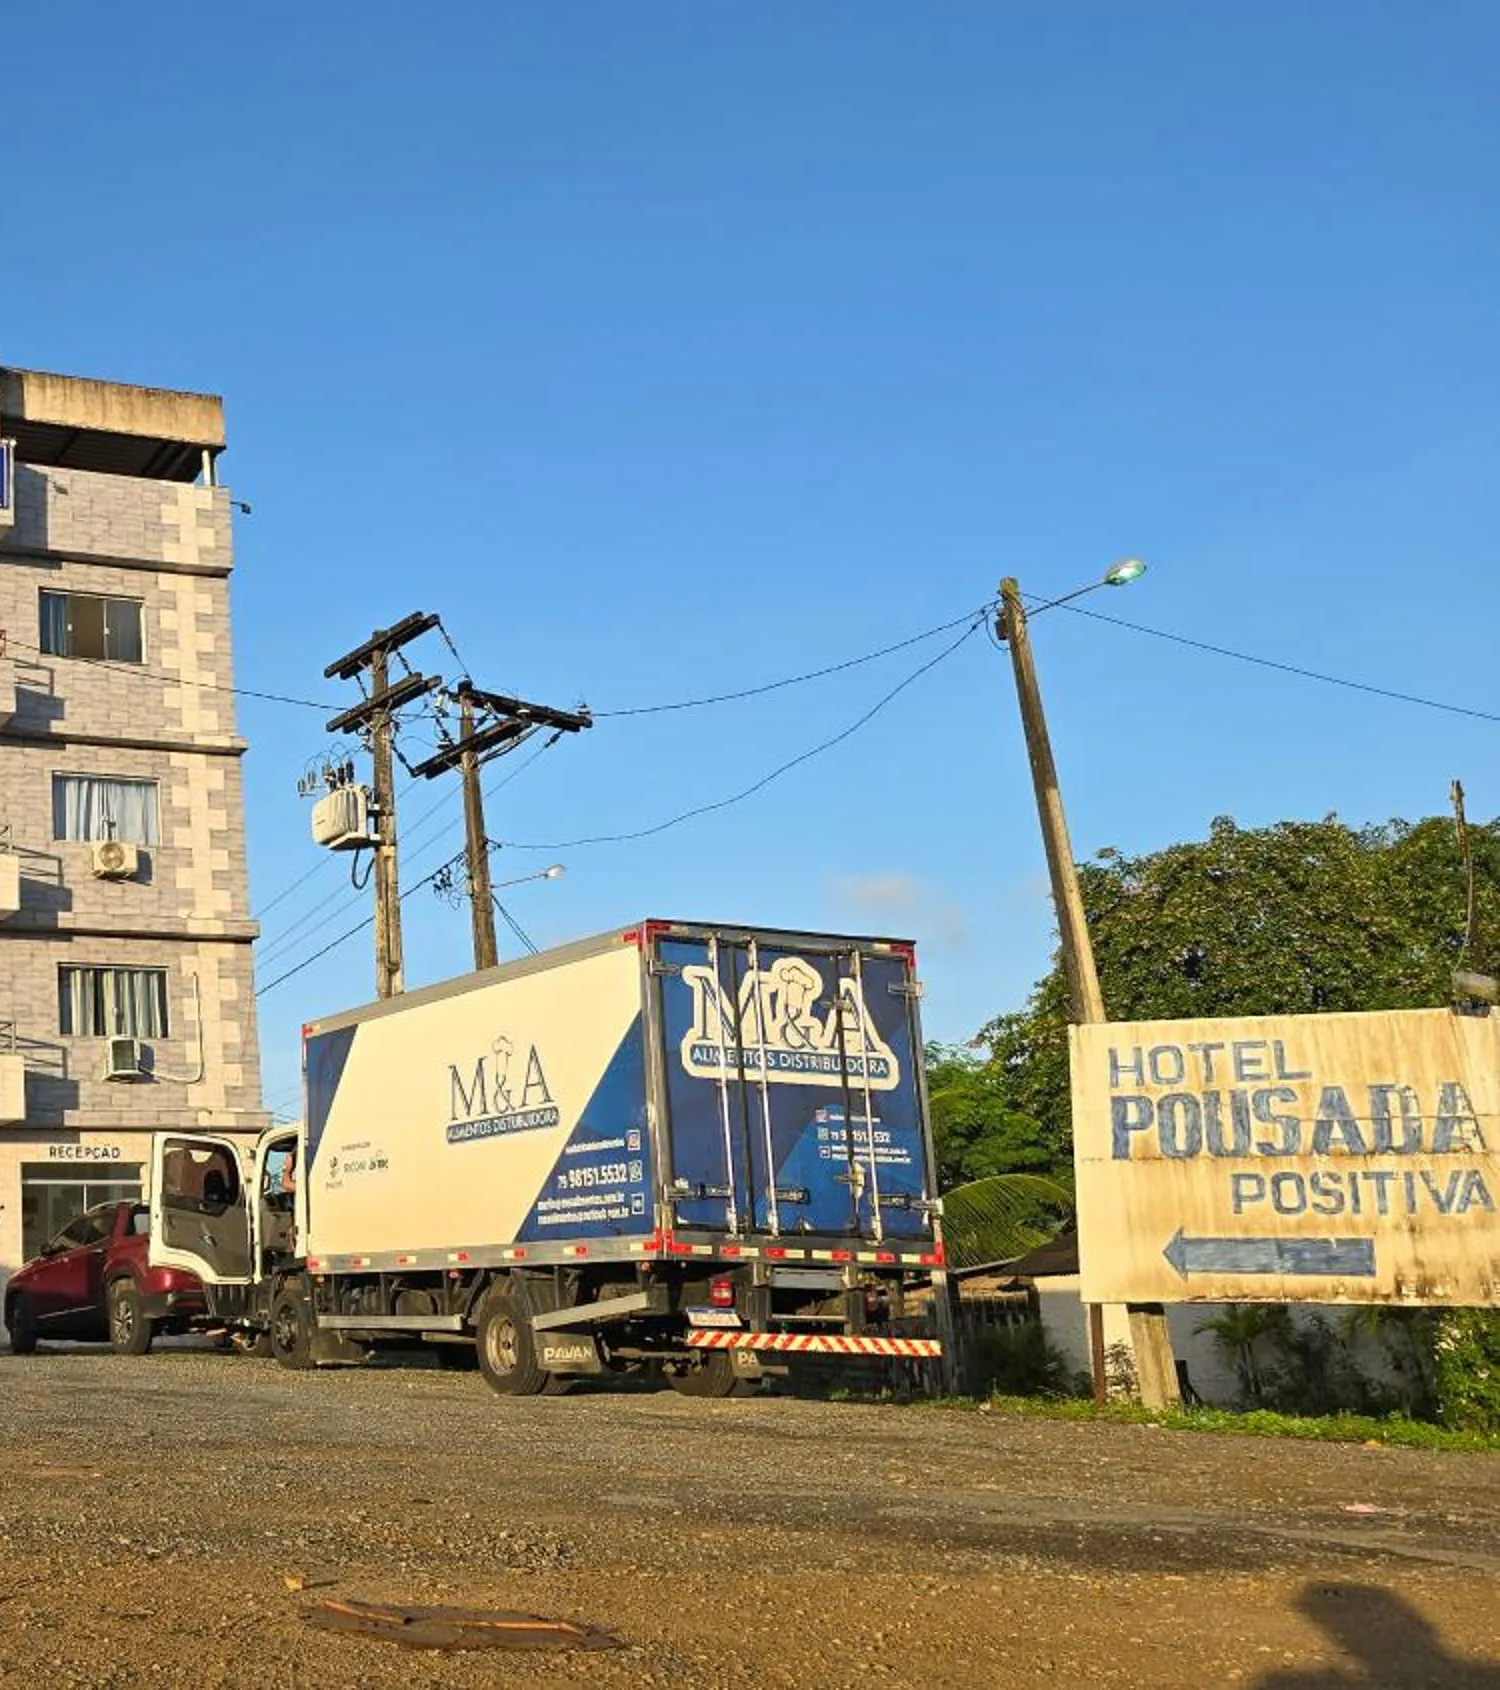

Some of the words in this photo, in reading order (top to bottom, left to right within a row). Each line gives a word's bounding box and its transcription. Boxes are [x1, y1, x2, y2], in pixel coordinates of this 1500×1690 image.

[447, 1043, 555, 1121] M&A
[779, 1051, 887, 1074] DISTRIBUDORA
[1108, 1039, 1313, 1089] HOTEL
[1111, 1081, 1487, 1161] POUSADA
[49, 1144, 121, 1161] RECEPÇÃO
[1232, 1169, 1496, 1217] POSITIVA
[544, 1345, 593, 1362] PAVAN
